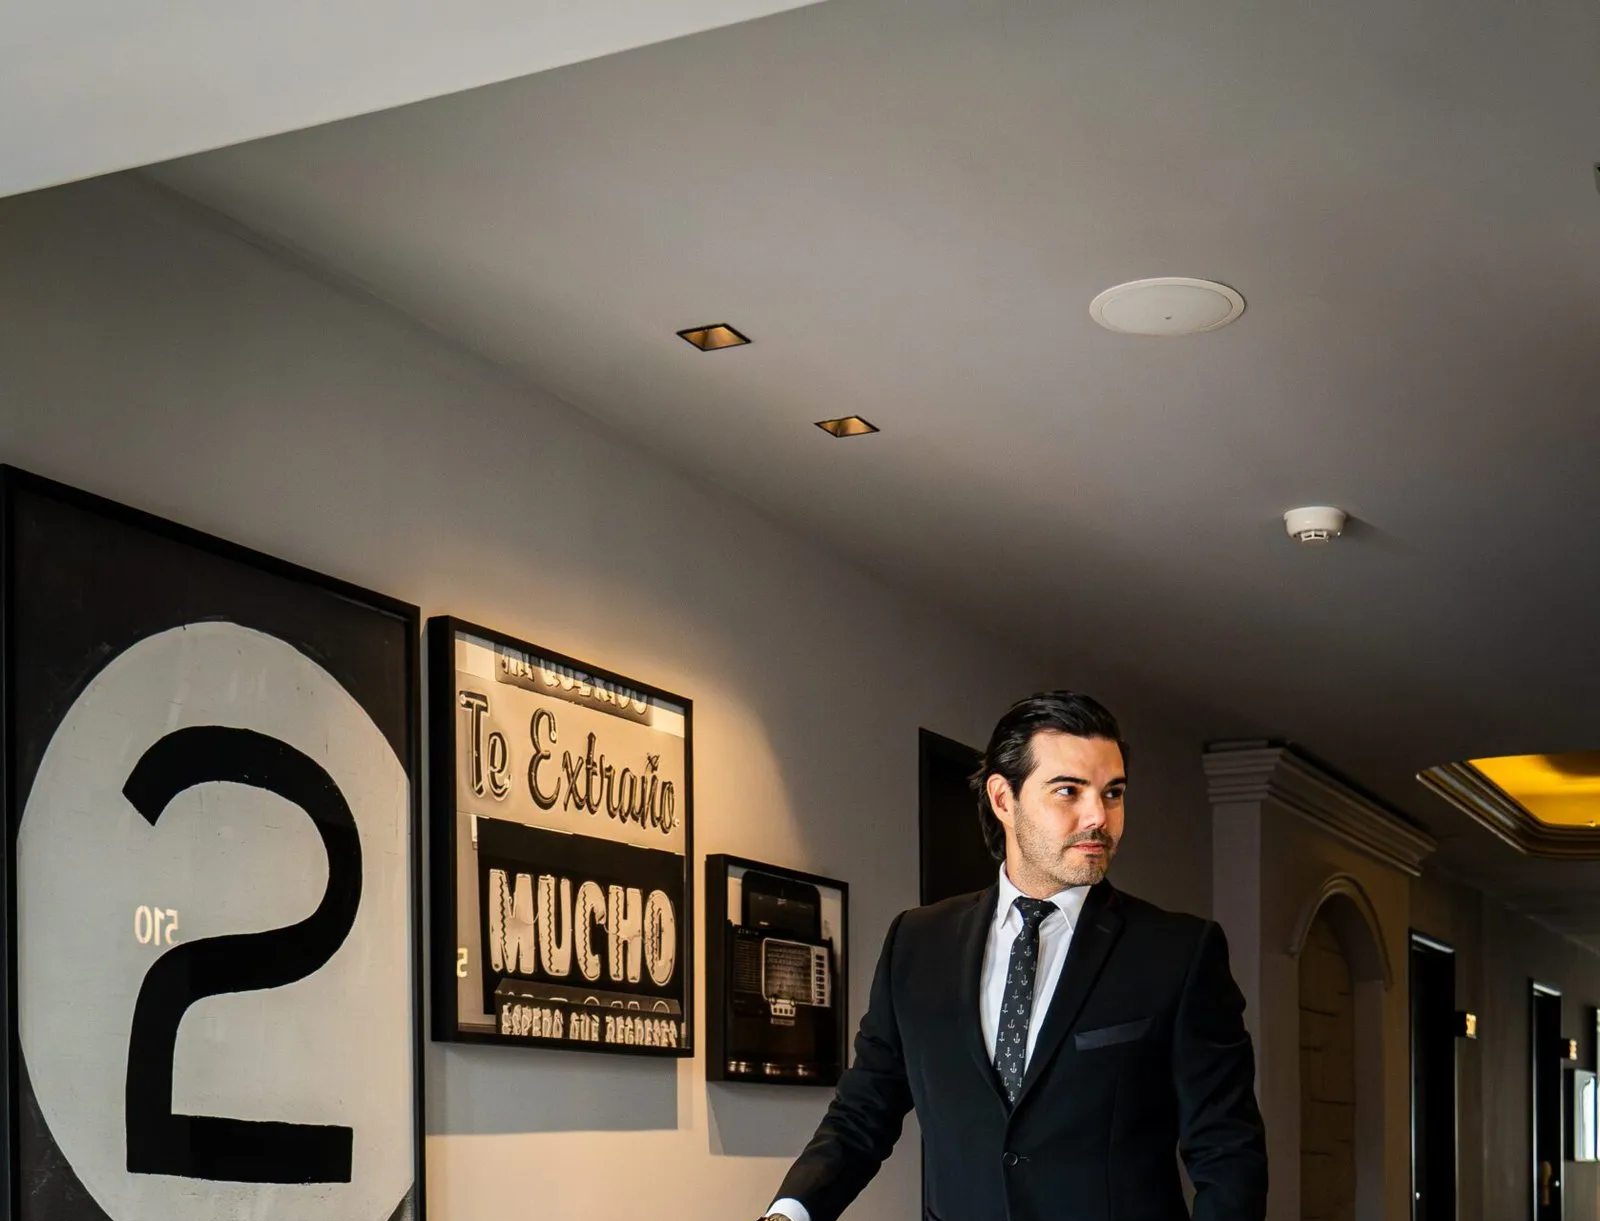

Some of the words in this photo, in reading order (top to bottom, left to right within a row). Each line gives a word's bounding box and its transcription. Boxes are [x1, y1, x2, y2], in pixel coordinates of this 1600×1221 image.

[459, 690, 511, 802] Te
[528, 707, 680, 834] Extraño
[122, 725, 363, 1184] 2
[489, 867, 677, 986] MUCHO
